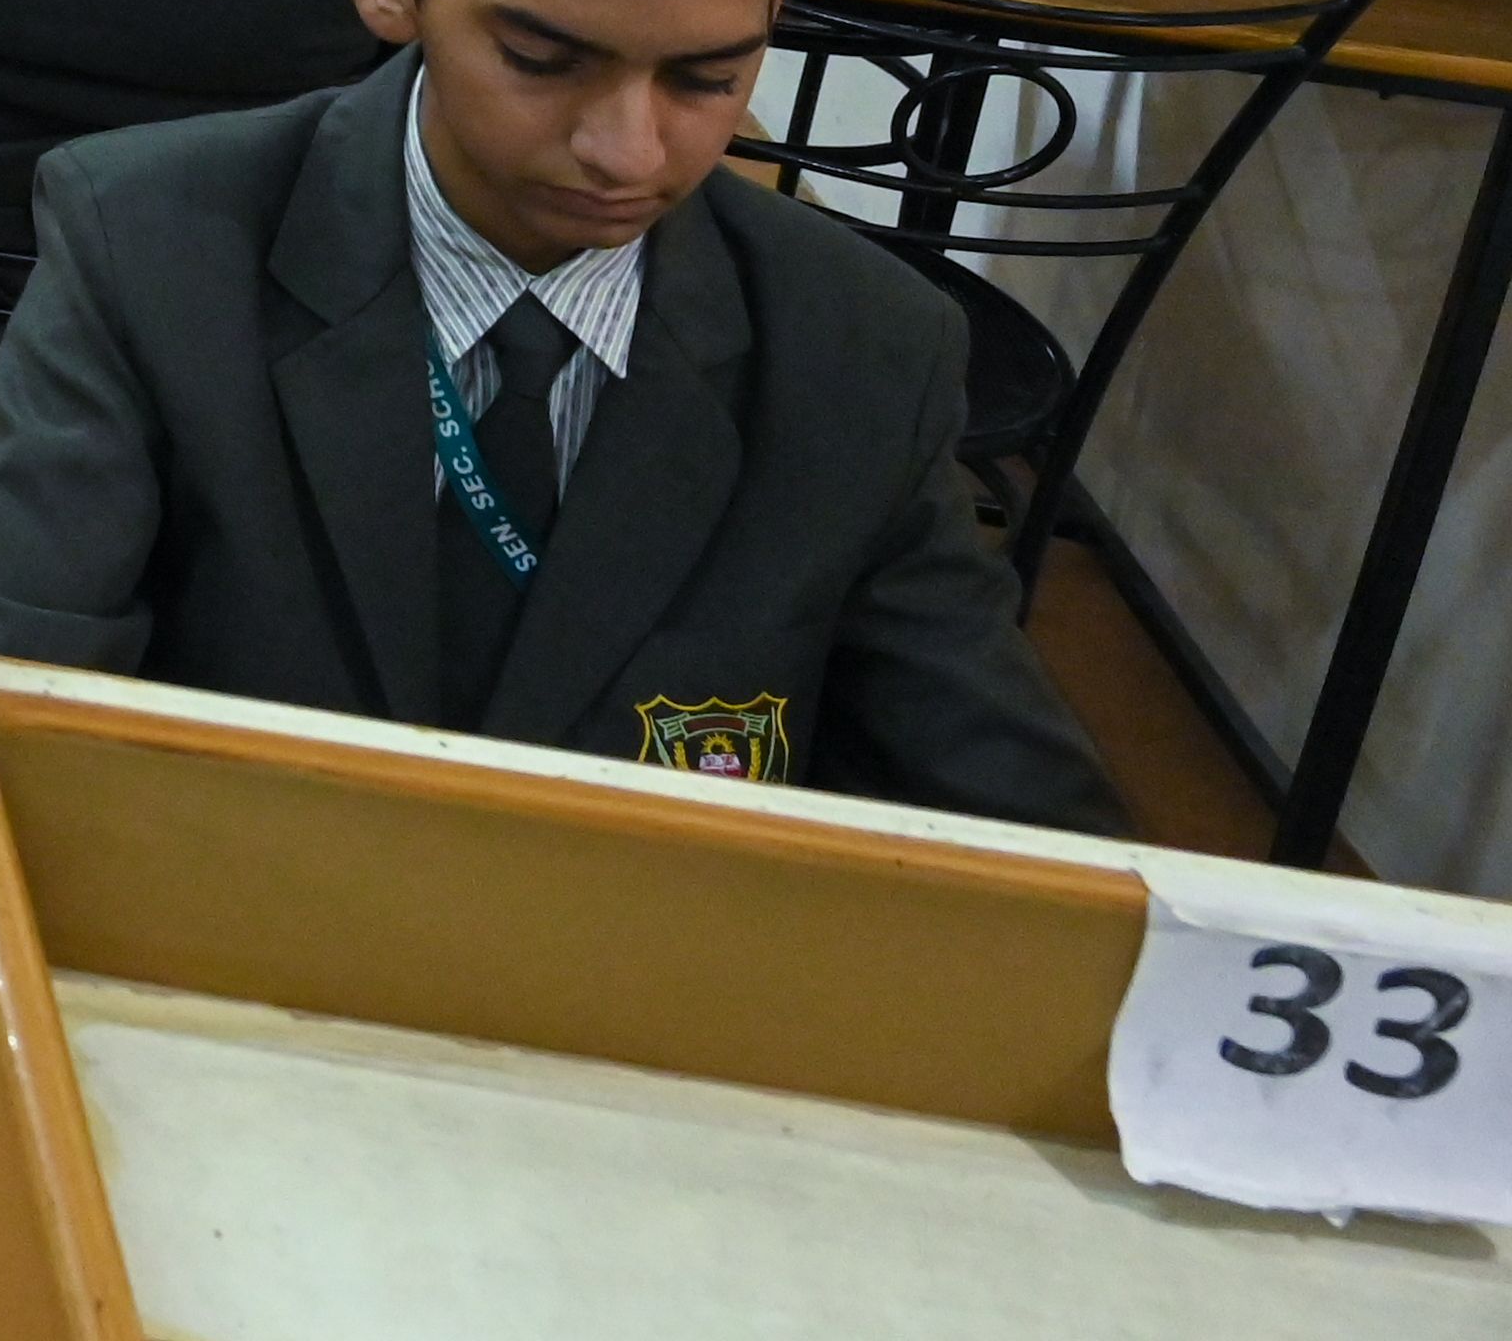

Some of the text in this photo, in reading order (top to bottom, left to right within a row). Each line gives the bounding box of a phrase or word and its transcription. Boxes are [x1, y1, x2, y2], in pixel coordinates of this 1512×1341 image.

[453, 445, 496, 510] SEC.
[490, 515, 538, 573] SEN.
[1219, 944, 1470, 1100] 33
